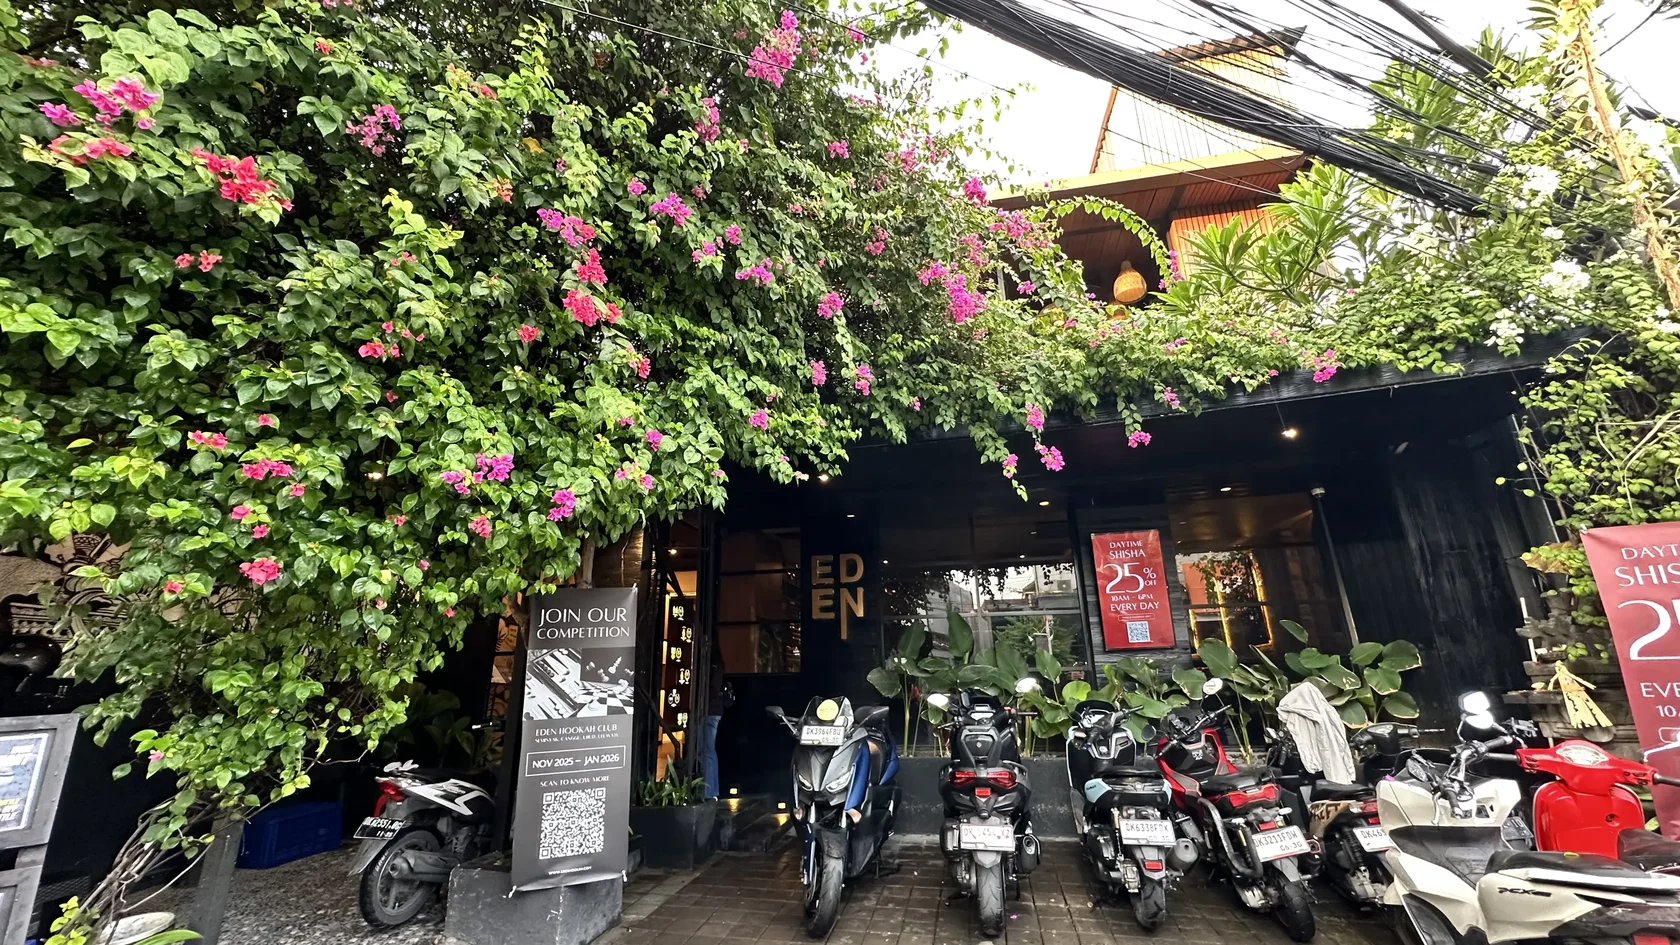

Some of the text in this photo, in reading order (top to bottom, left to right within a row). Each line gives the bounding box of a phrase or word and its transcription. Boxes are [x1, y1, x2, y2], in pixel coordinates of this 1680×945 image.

[1109, 540, 1143, 548] DAYTIME
[1109, 549, 1146, 560] SHISHA
[1621, 543, 1678, 560] DAYT
[1614, 562, 1680, 587] SHIS
[1110, 601, 1159, 612] EVERY DAY
[538, 607, 627, 627] JOIN OUR
[536, 626, 630, 639] COMPETITION
[1617, 599, 1680, 660] 2
[1656, 705, 1680, 717] 10
[535, 723, 618, 737] EDEN HOOKAH CLUB
[532, 758, 553, 768] NOV
[554, 757, 574, 767] 2025
[583, 755, 599, 766] JAN
[600, 753, 620, 763] 2026
[570, 777, 590, 785] KNOW
